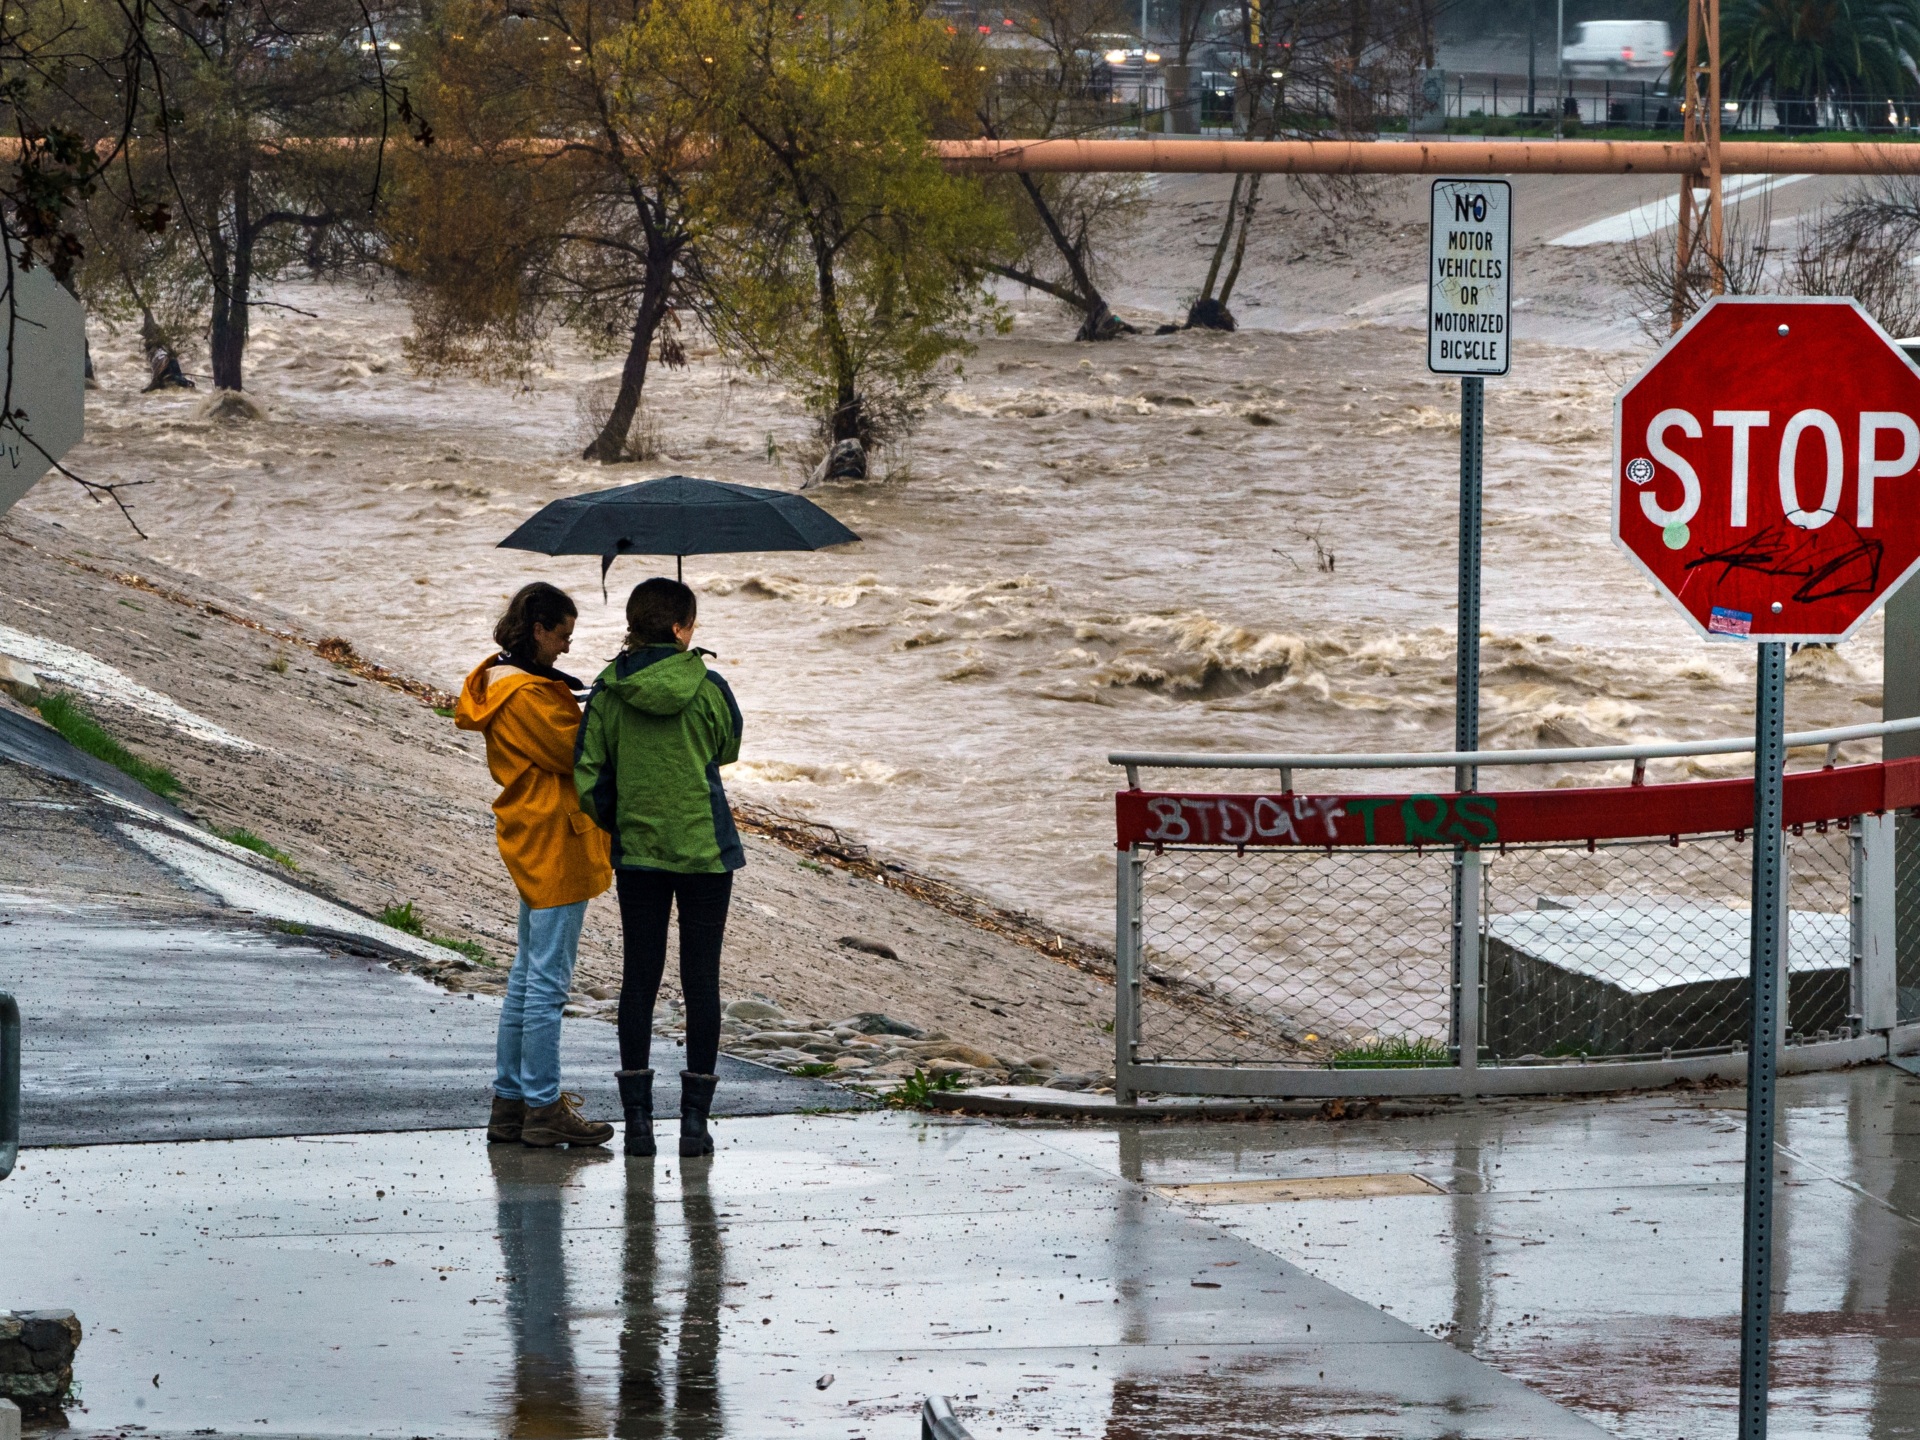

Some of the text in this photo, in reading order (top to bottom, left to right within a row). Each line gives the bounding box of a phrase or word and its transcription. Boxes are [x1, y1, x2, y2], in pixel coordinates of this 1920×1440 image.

[1455, 194, 1487, 222] NO
[1448, 231, 1493, 251] MOTOR
[1438, 258, 1502, 279] VEHICLES
[1461, 286, 1478, 305] OR
[1435, 313, 1504, 333] MOTORIZED
[1441, 340, 1497, 360] BICYCLE
[1639, 408, 1920, 530] STOP
